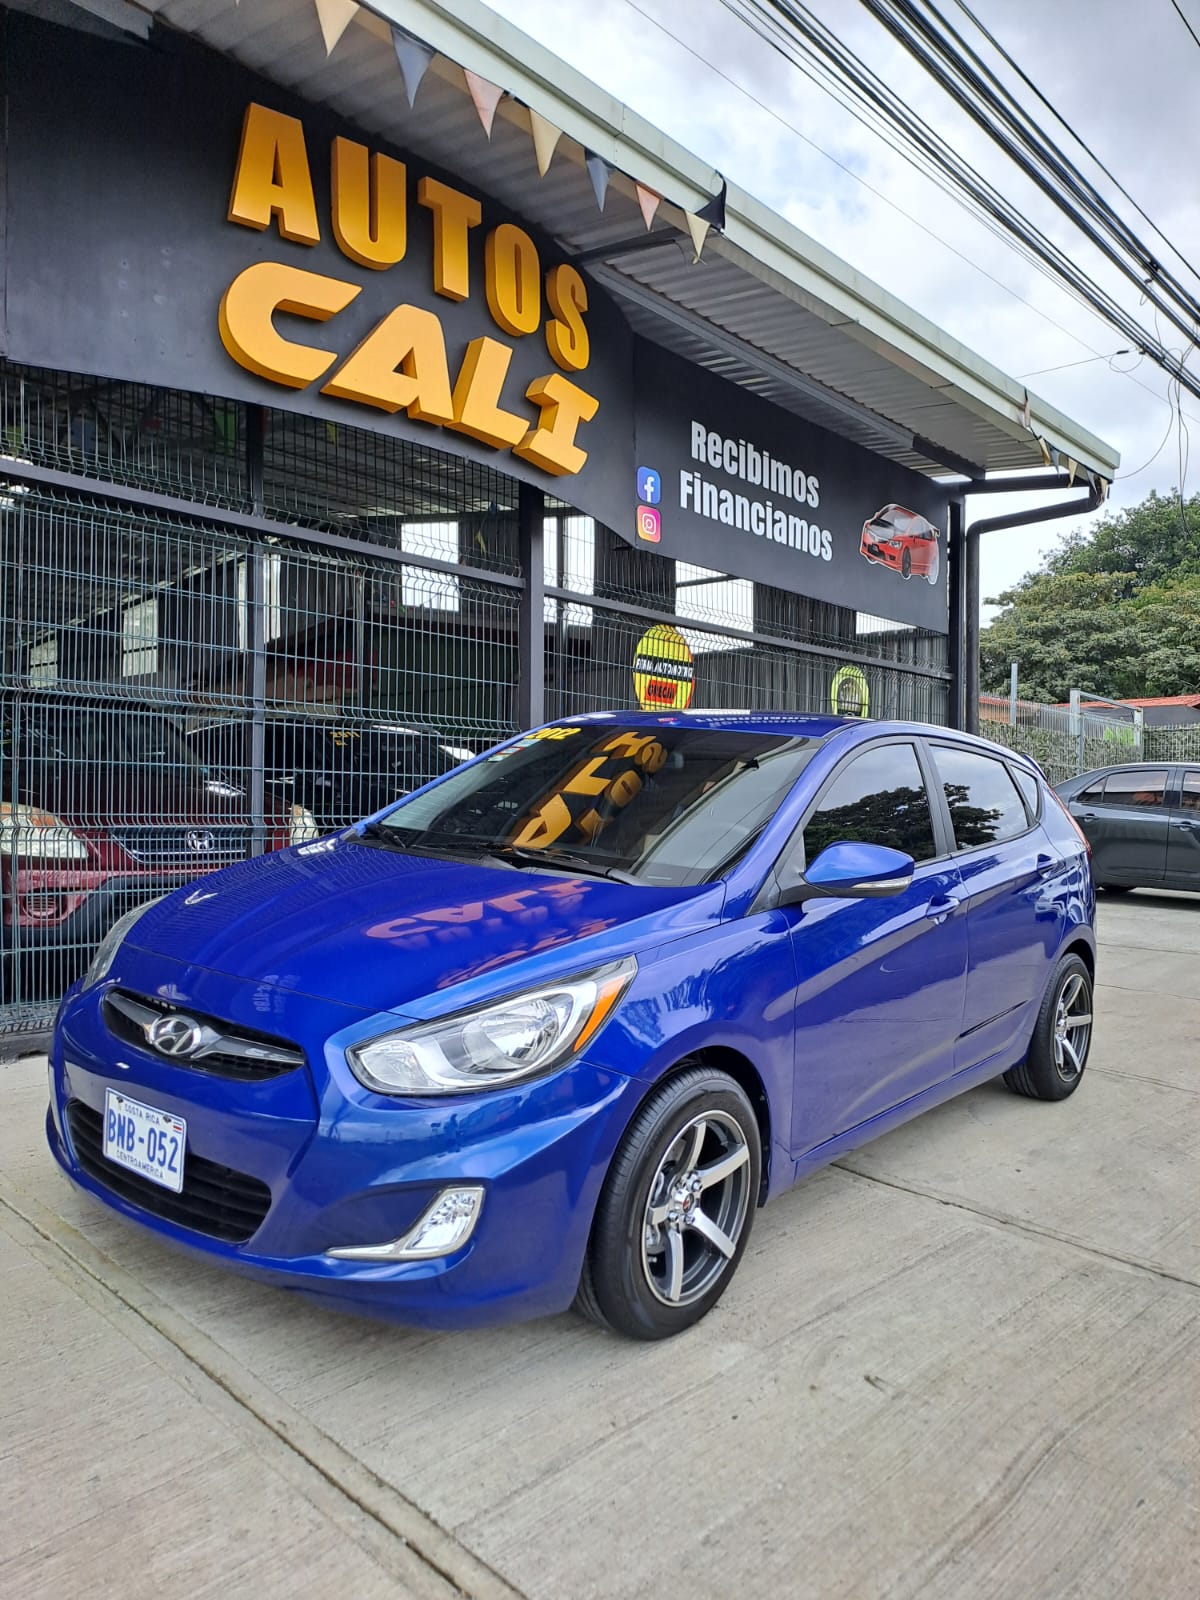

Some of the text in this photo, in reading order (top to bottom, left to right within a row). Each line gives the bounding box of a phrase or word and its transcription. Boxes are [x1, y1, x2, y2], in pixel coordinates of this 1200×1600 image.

[228, 102, 590, 371] AUTOS
[218, 261, 599, 476] CALI
[691, 420, 819, 508] Recibimos
[680, 469, 833, 562] Financiamos
[108, 1108, 178, 1173] BNB-052
[124, 1103, 160, 1125] COSTA RICA
[116, 1149, 164, 1179] CENTROAMERICA
